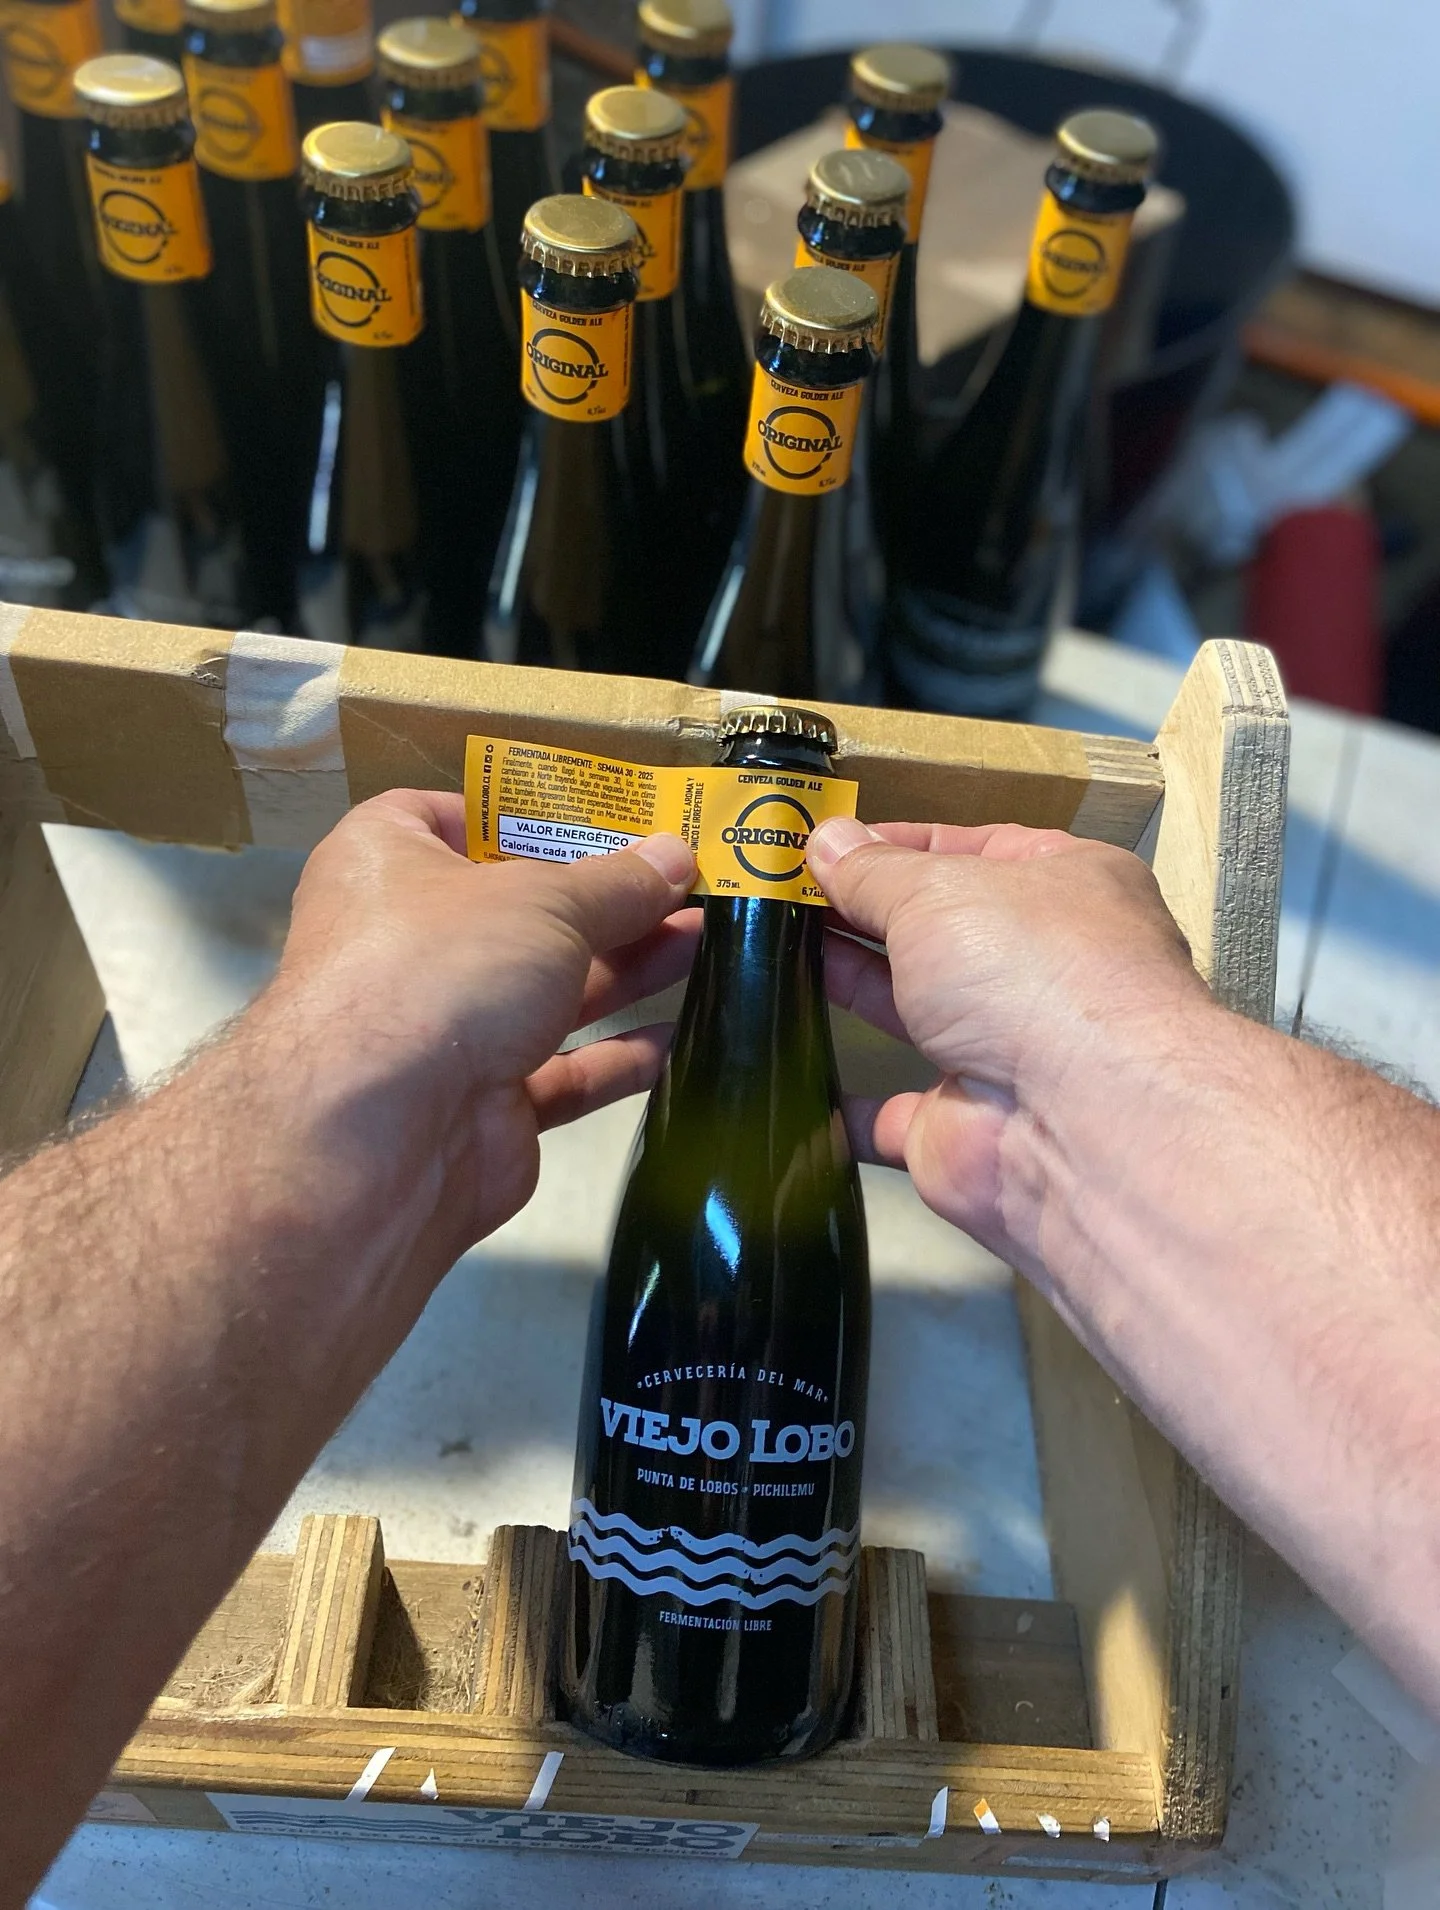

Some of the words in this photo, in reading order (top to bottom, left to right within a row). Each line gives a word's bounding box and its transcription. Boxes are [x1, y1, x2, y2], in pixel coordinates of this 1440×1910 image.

[526, 341, 609, 379] ORIGINAL
[770, 378, 799, 397] CERVEZA
[800, 391, 829, 401] GOLDEN
[830, 390, 844, 401] ALE
[757, 419, 843, 453] ORIGINAL
[508, 746, 550, 761] FERMENTADA
[552, 754, 593, 769] LIBREMENTE
[597, 762, 624, 776] SEMANA
[625, 768, 634, 778] 30
[638, 770, 654, 781] 2025
[537, 763, 558, 773] cuando
[579, 769, 585, 777] la
[589, 772, 610, 783] semana
[625, 779, 635, 788] los
[637, 782, 657, 791] vientos
[501, 767, 529, 778] cambiaron
[536, 771, 552, 780] Norte
[579, 779, 592, 789] algo
[593, 781, 601, 790] de
[631, 790, 639, 798] un
[640, 791, 656, 800] clima
[547, 783, 568, 793] cuando
[568, 786, 600, 798] fermentaba
[600, 791, 629, 804] libremente
[641, 799, 655, 810] Viejo
[684, 783, 694, 806] AROMA
[737, 774, 773, 785] CERVEZA
[776, 777, 806, 789] GOLDEN
[807, 780, 823, 792] ALE
[481, 775, 491, 842] WWW.VIEJOLOBO.CL
[514, 787, 537, 798] también
[576, 796, 586, 805] tan
[586, 798, 614, 810] esperadas
[637, 807, 654, 817] Clima
[692, 782, 704, 825] IRREPETIBLE
[585, 808, 596, 816] con
[596, 809, 605, 817] un
[605, 810, 617, 819] Mar
[617, 814, 628, 823] que
[641, 818, 653, 826] una
[516, 822, 553, 836] VALOR
[555, 827, 629, 847] ENERGÉTICO
[722, 826, 810, 851] ORIGINA
[501, 839, 540, 854] Calorías
[542, 847, 567, 858] cada
[571, 849, 588, 860] 100
[644, 1362, 746, 1388] CERVECERÍA
[757, 1368, 784, 1387] DEL
[793, 1378, 824, 1401] MAR
[600, 1397, 741, 1460] VIEJO
[749, 1418, 856, 1464] LOBO
[637, 1467, 674, 1488] PUNTA
[679, 1476, 696, 1490] DE
[700, 1479, 739, 1495] LOBOS
[753, 1482, 816, 1497] PICHILEMU
[659, 1610, 740, 1631] FERMENTACIÓN
[744, 1619, 773, 1632] LIBRE
[443, 1809, 746, 1838] VIEJO
[495, 1824, 736, 1850] LOBO
